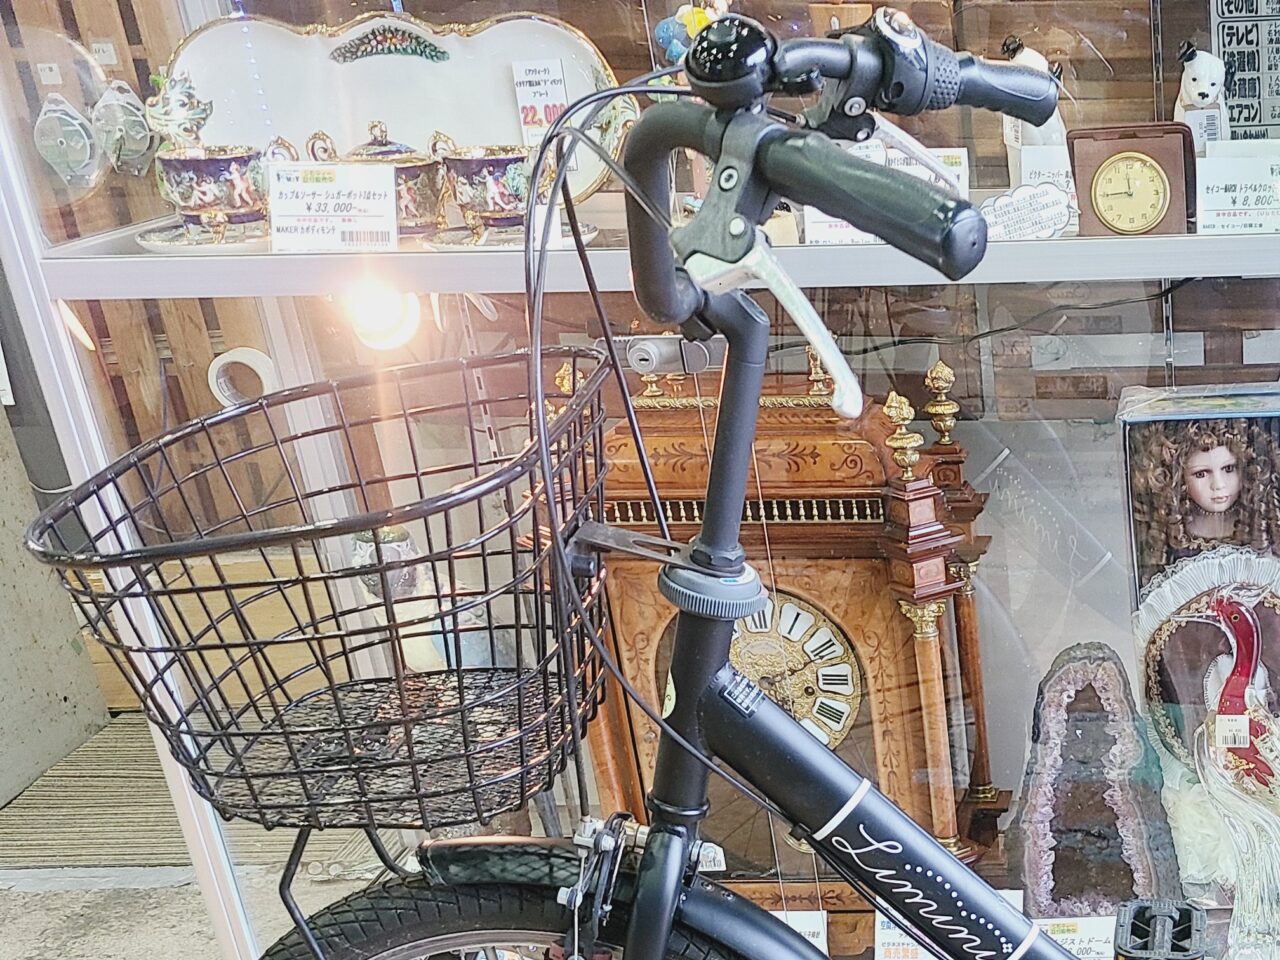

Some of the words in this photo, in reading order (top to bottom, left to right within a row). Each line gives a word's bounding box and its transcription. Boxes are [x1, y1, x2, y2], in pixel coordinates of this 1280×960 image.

[1055, 936, 1112, 946] ジストドーム
